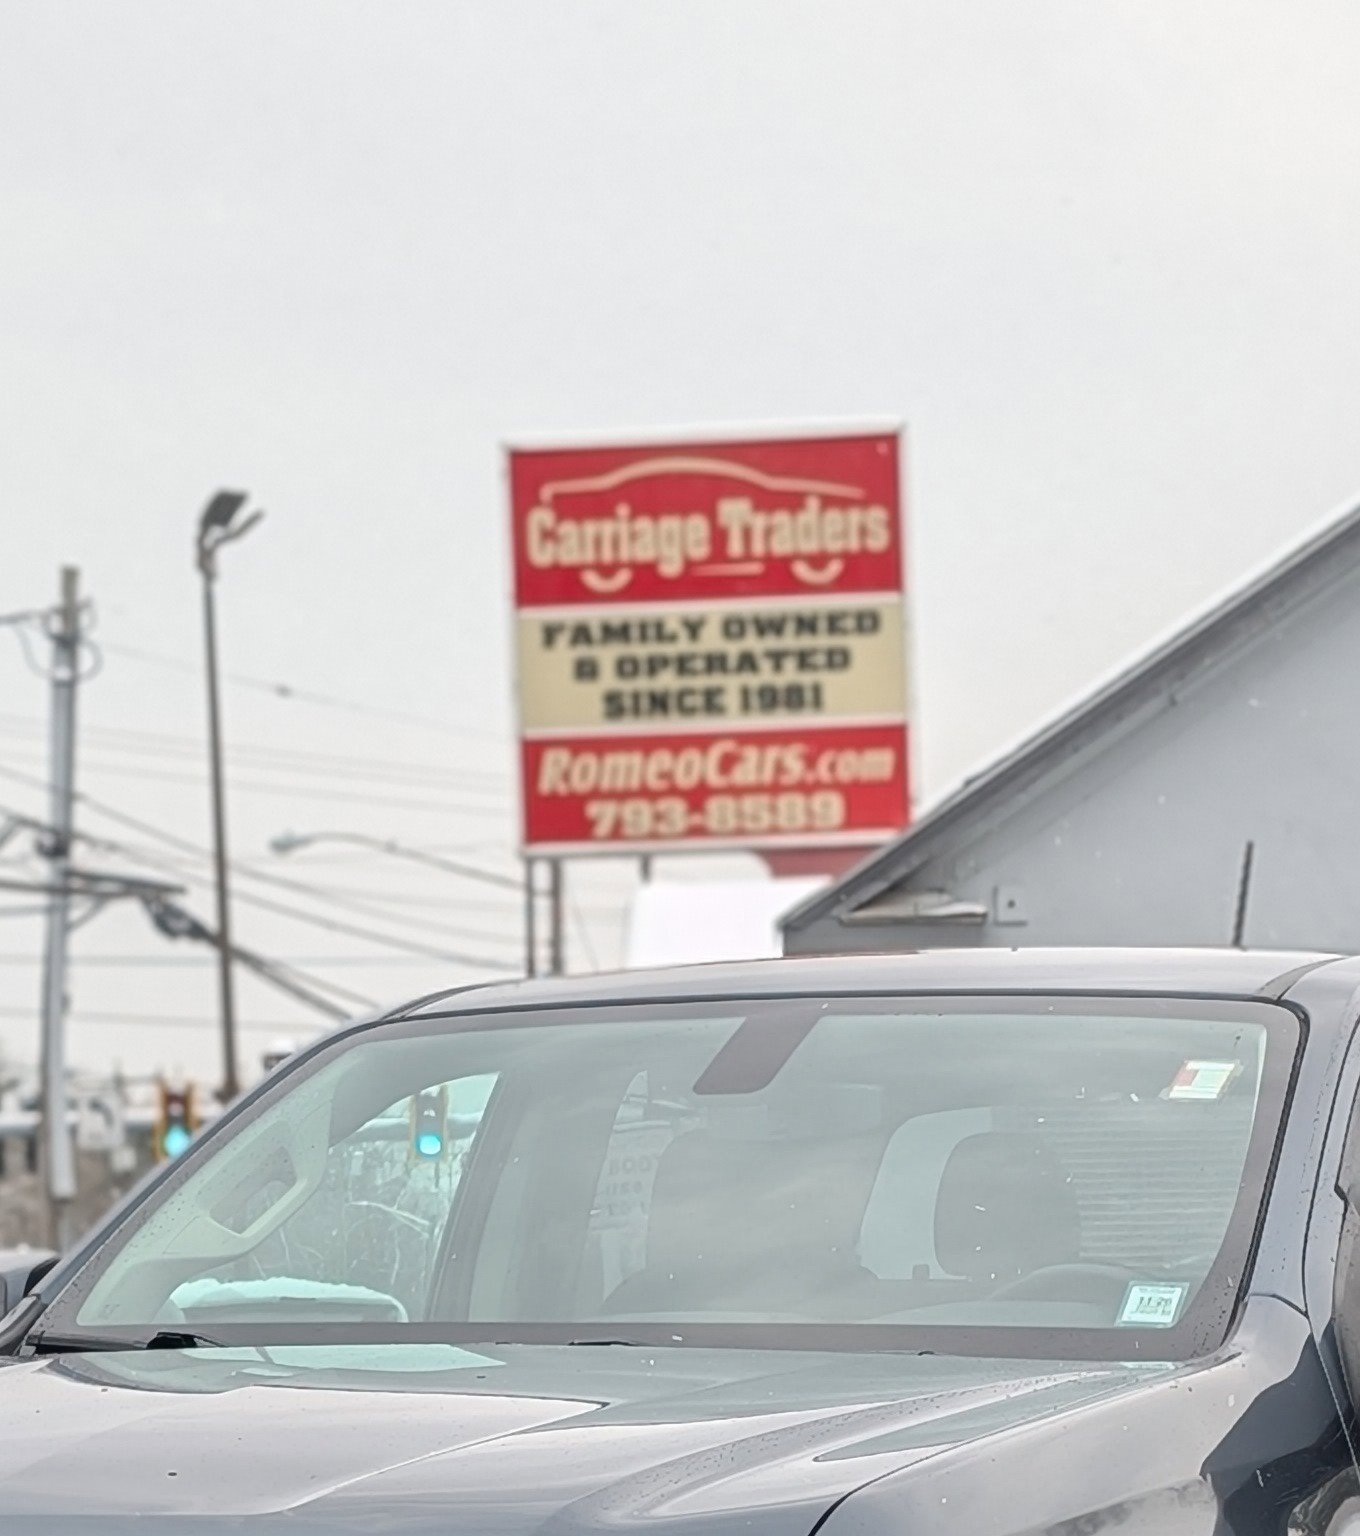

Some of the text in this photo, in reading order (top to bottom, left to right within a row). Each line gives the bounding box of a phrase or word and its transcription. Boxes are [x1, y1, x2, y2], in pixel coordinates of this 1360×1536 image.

[526, 494, 890, 578] Carriage Traders
[542, 609, 882, 650] FAMILY OWNED
[615, 646, 853, 680] OPERATED
[603, 682, 824, 721] SINCE 1981
[538, 738, 896, 797] RomeoCars.com
[584, 789, 847, 838] 793-8589
